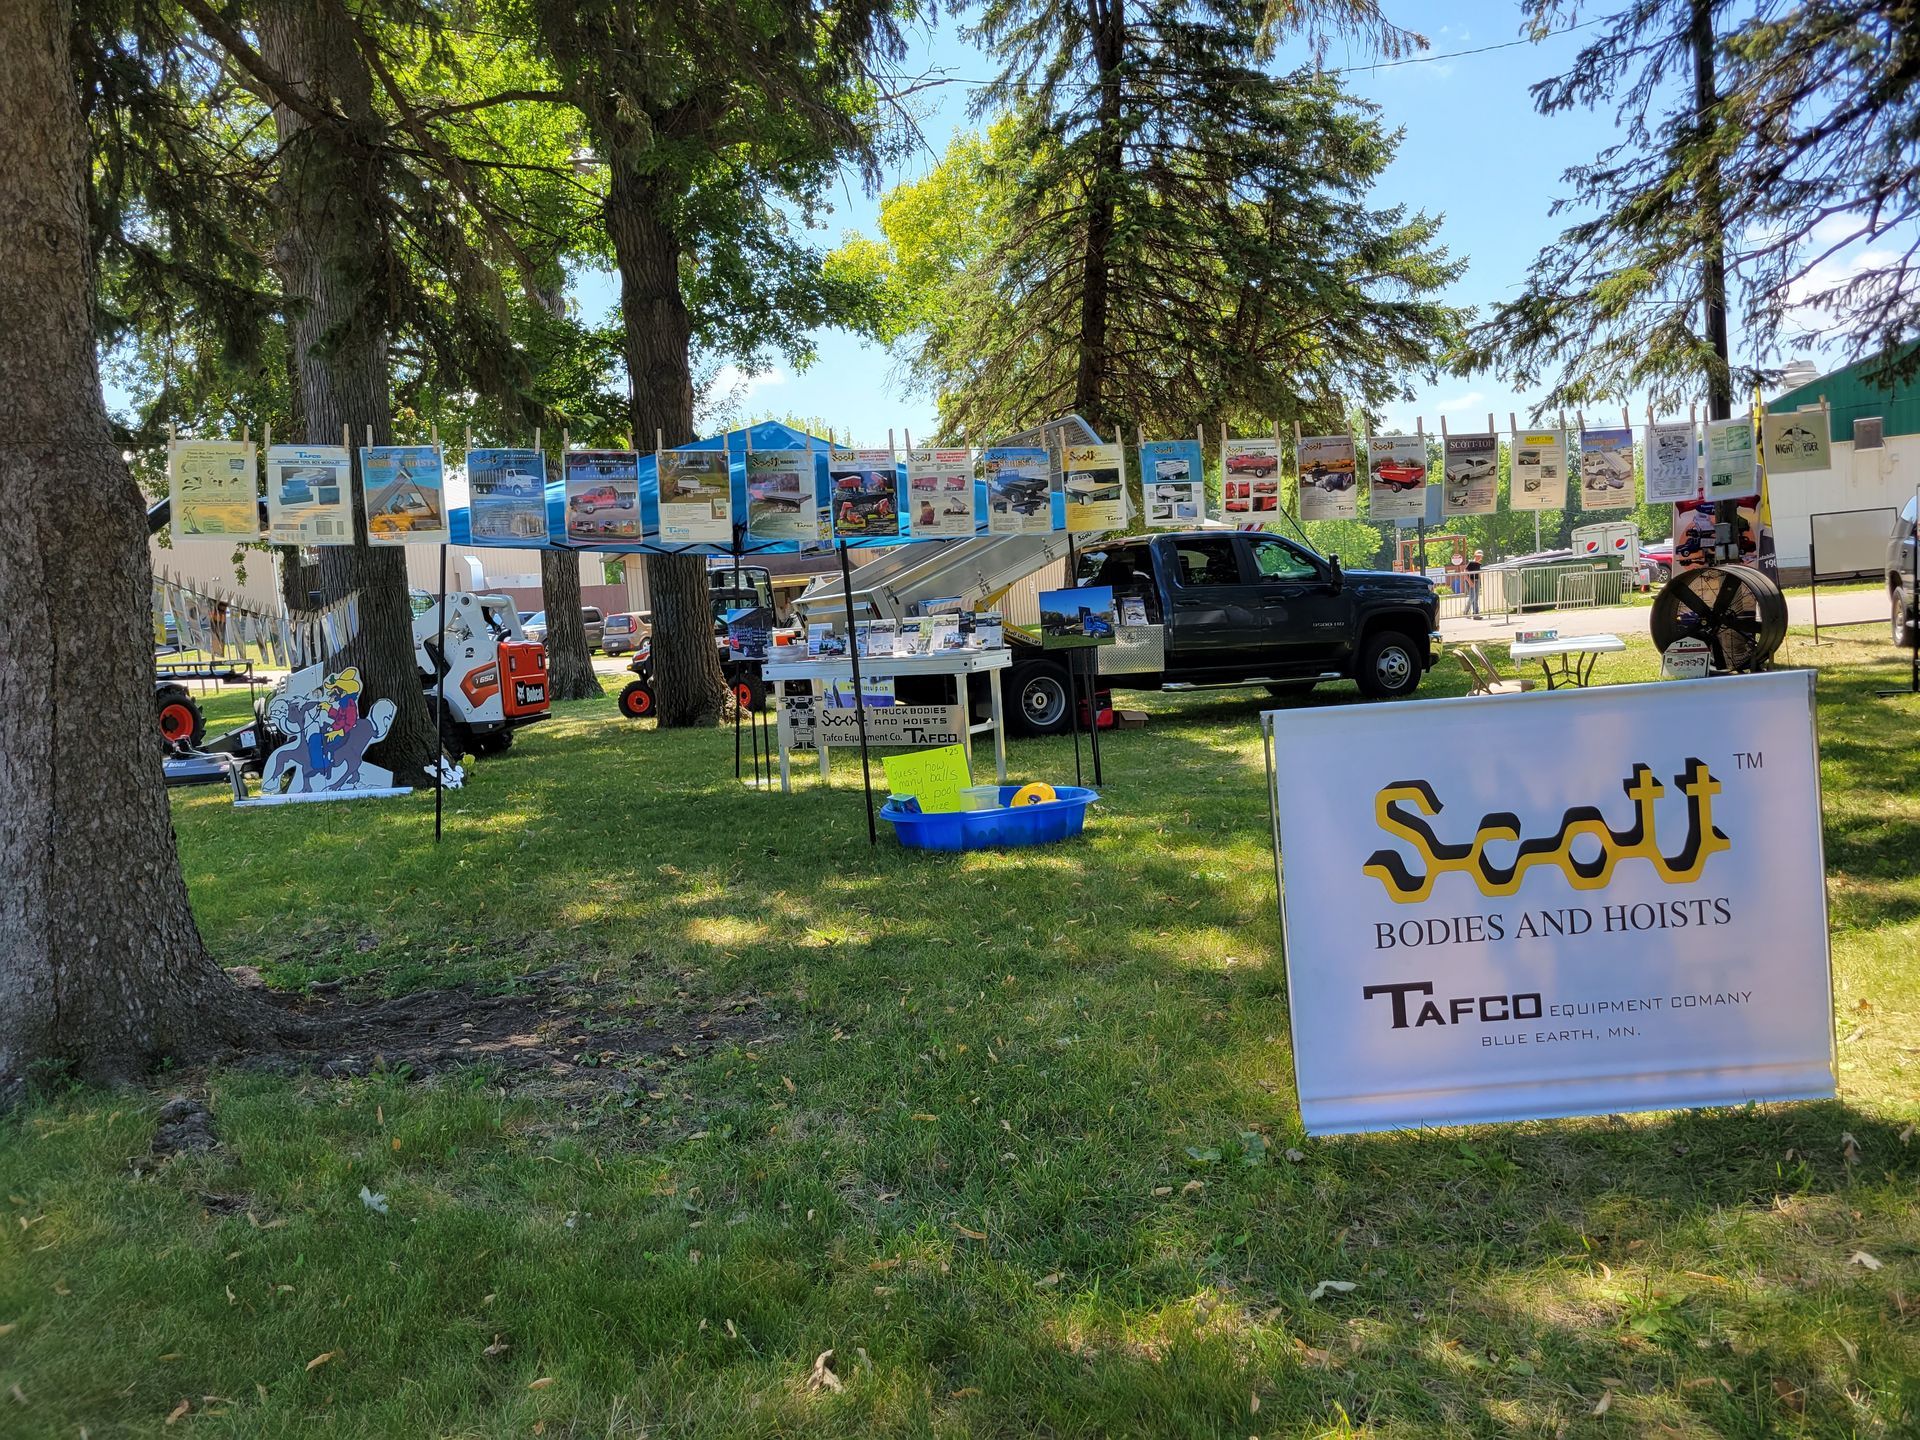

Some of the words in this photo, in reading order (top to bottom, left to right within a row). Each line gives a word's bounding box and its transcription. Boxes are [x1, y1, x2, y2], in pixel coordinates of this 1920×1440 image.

[295, 451, 322, 459] TAFCO
[1775, 443, 1794, 455] NIGHT
[1803, 442, 1820, 452] RIDER
[525, 685, 545, 703] Bobcat
[873, 707, 908, 716] TRUCK
[910, 706, 947, 715] BODIES
[874, 718, 898, 726] AND
[903, 717, 948, 726] HOISTS
[821, 733, 843, 742] Tafco
[844, 733, 889, 744] Equment
[889, 732, 903, 742] Co.
[902, 728, 958, 744] TAFCO
[890, 764, 919, 781] Guess
[924, 760, 945, 772] how
[898, 777, 924, 797] many
[929, 766, 959, 783] balls
[933, 784, 957, 803] pool
[1362, 756, 1731, 904] Scott
[1733, 752, 1763, 770] TM
[1373, 913, 1506, 950] BODIES
[1514, 908, 1593, 939] AND
[1602, 896, 1732, 933] HOISTS
[1362, 980, 1543, 1030] TAFCO
[1549, 996, 1664, 1018] EQUIPMENT
[1669, 991, 1753, 1009] COMANY
[1481, 1032, 1528, 1047] BLUE
[1534, 1028, 1601, 1044] EARTH,
[1607, 1026, 1642, 1039] MN.
